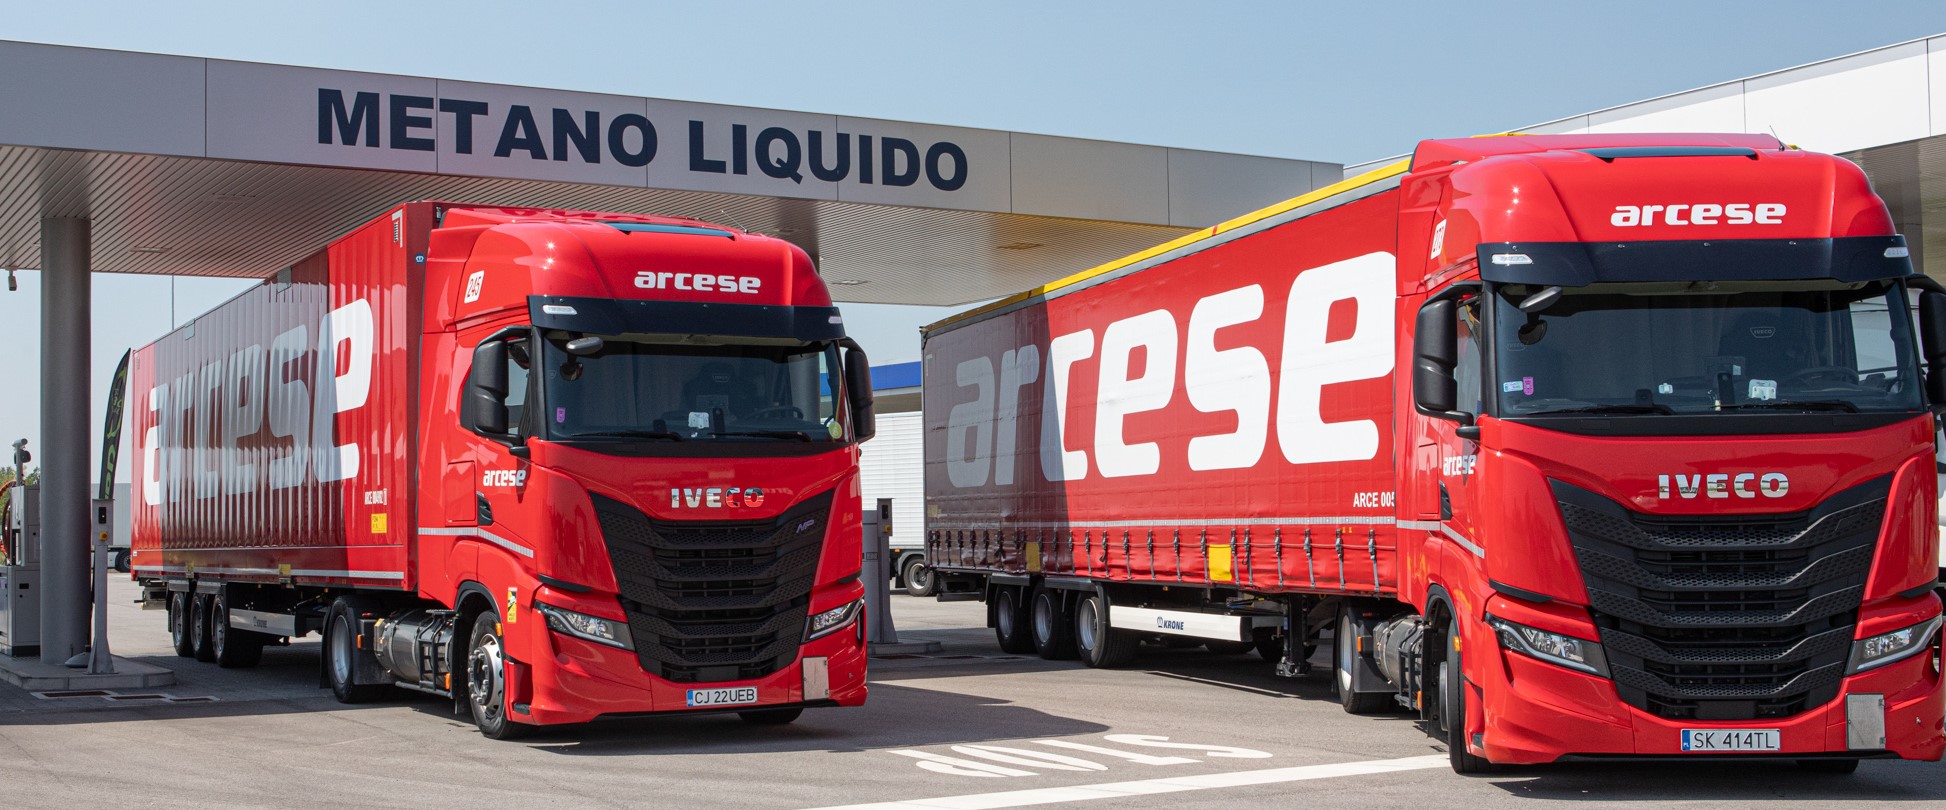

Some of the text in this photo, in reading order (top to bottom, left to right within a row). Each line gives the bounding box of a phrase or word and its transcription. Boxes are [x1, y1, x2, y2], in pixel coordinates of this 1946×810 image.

[318, 88, 968, 191] METANO LIQUIDO
[1610, 203, 1787, 227] arcese
[466, 275, 482, 298] 245
[634, 270, 761, 294] arcese
[947, 251, 1397, 488] arcese
[143, 298, 374, 506] arcese
[1443, 455, 1477, 476] arcese
[483, 469, 527, 487] arcese
[1658, 472, 1789, 499] IVECO
[671, 487, 764, 508] IVECO
[1353, 492, 1378, 508] ARCE
[1163, 620, 1184, 630] KRONE
[694, 688, 755, 704] CJ 22UEB
[1694, 732, 1775, 749] SK 414TL
[886, 734, 1273, 777] STOP
